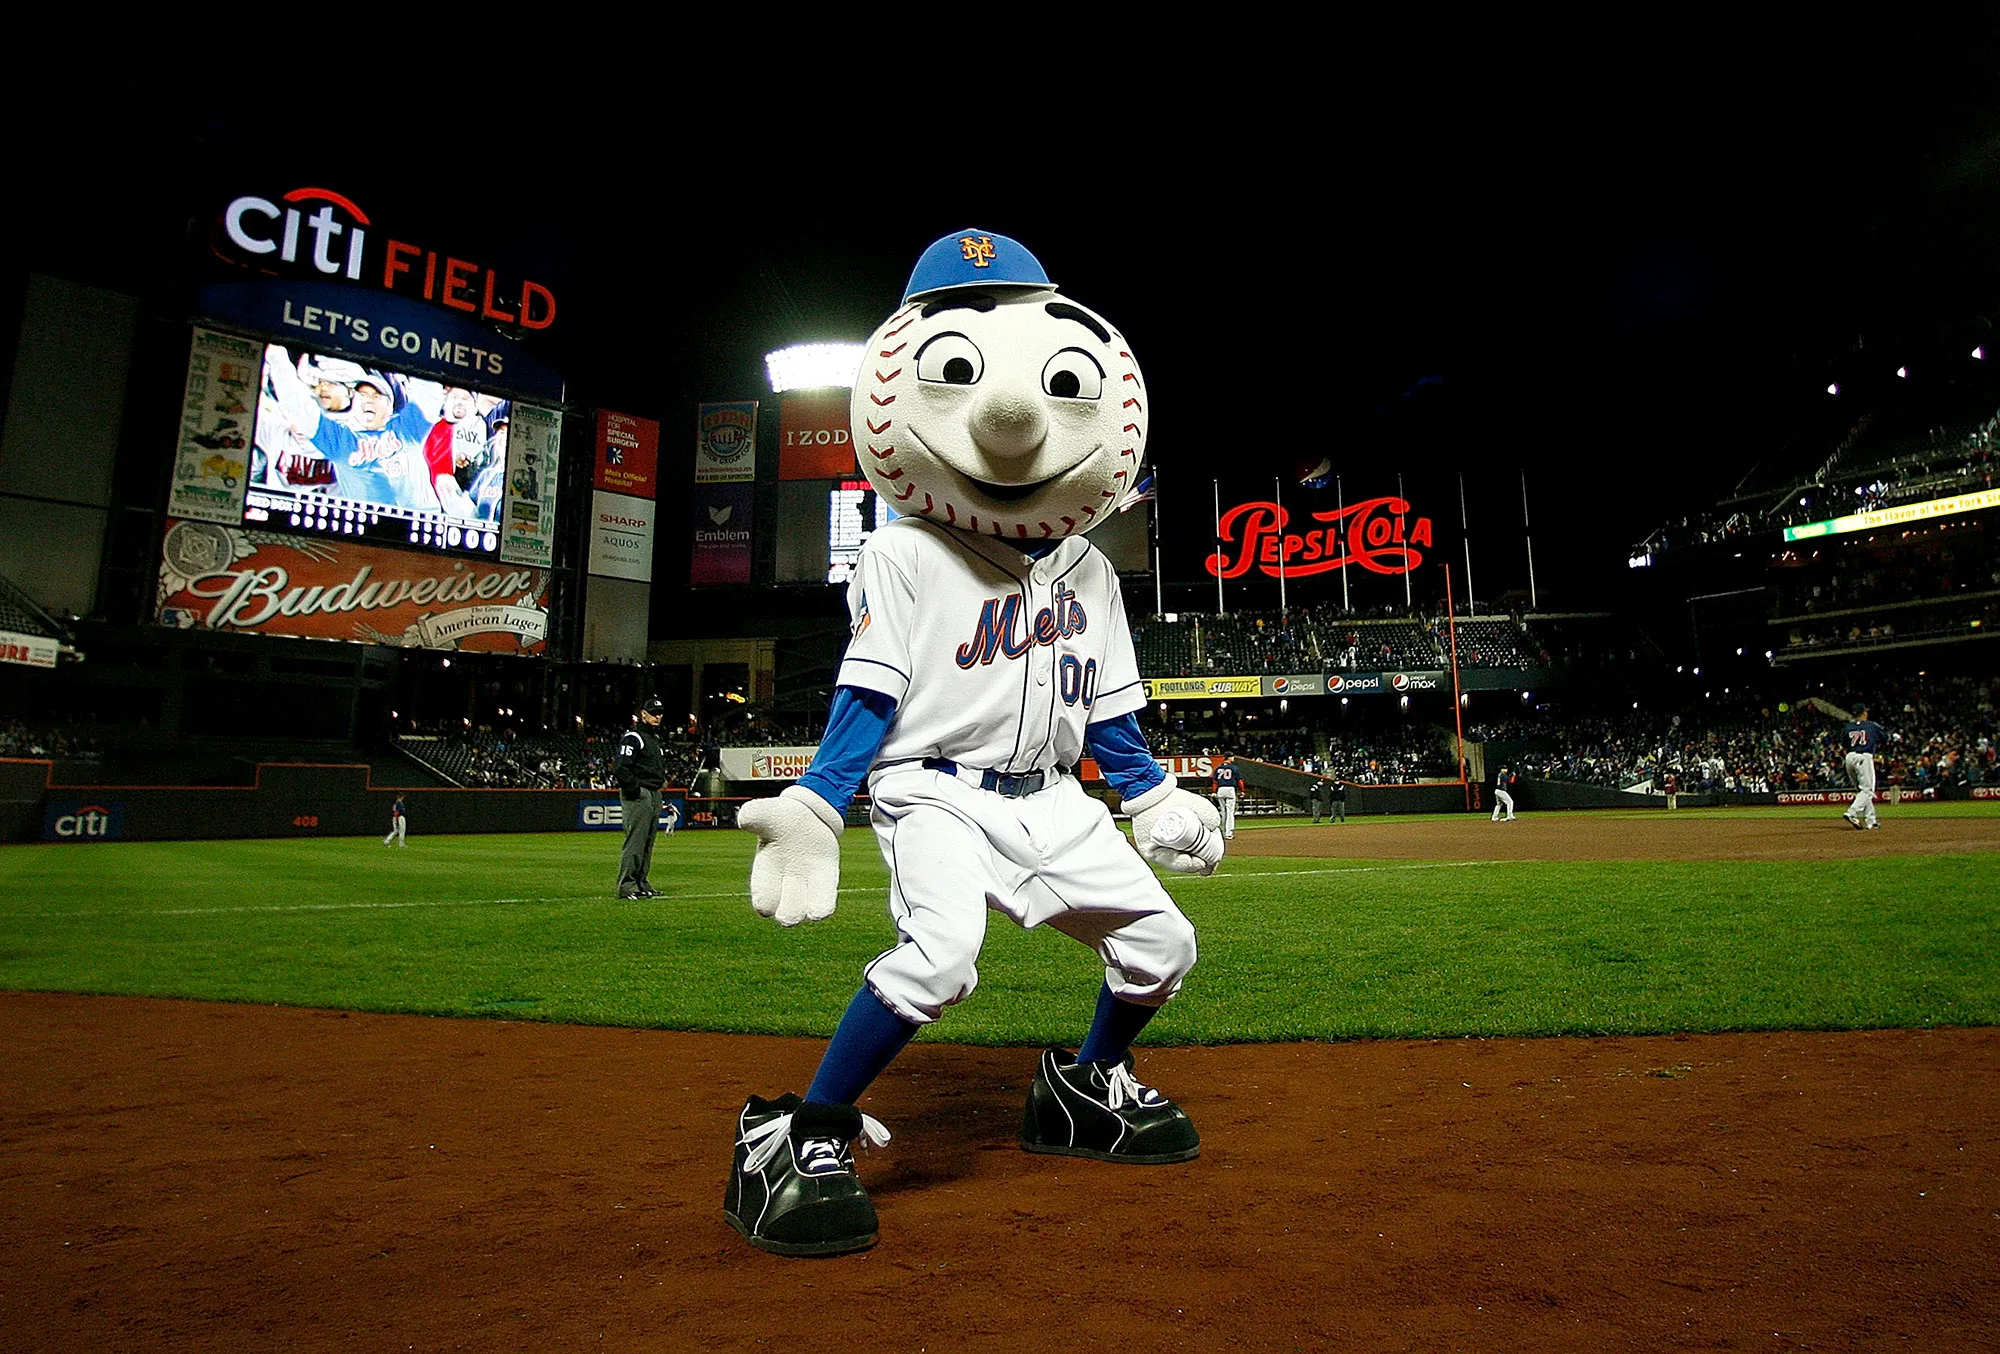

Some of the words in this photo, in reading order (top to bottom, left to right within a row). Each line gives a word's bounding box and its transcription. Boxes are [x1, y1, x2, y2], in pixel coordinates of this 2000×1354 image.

[226, 196, 365, 280] citi
[384, 238, 556, 330] FIELD
[283, 300, 370, 342] LET'S
[379, 326, 421, 354] GO
[430, 338, 503, 375] METS
[608, 421, 620, 429] FOR
[608, 428, 635, 440] SPECIAL
[787, 430, 848, 446] IZOD
[607, 436, 639, 448] SURGERY
[540, 432, 558, 536] SALES
[600, 513, 646, 528] SHARP
[696, 529, 750, 541] Emblem
[603, 536, 640, 549] AQUOS
[187, 562, 531, 629] Budweiser
[435, 614, 500, 639] American
[503, 613, 542, 631] Lager
[956, 580, 1087, 670] Mets
[1059, 653, 1097, 710] 00
[1160, 680, 1206, 692] FOOTLONGS
[1208, 679, 1260, 694] SUBWAY
[1290, 682, 1315, 692] pepsi
[1345, 677, 1379, 690] pepsi
[1410, 679, 1436, 689] max
[1849, 730, 1867, 747] 71
[773, 755, 812, 766] DUNK
[1156, 757, 1213, 778] ELL'S
[773, 766, 807, 777] DON
[1217, 768, 1232, 780] 70
[1790, 793, 1825, 802] TOYOTA
[55, 812, 108, 836] citi
